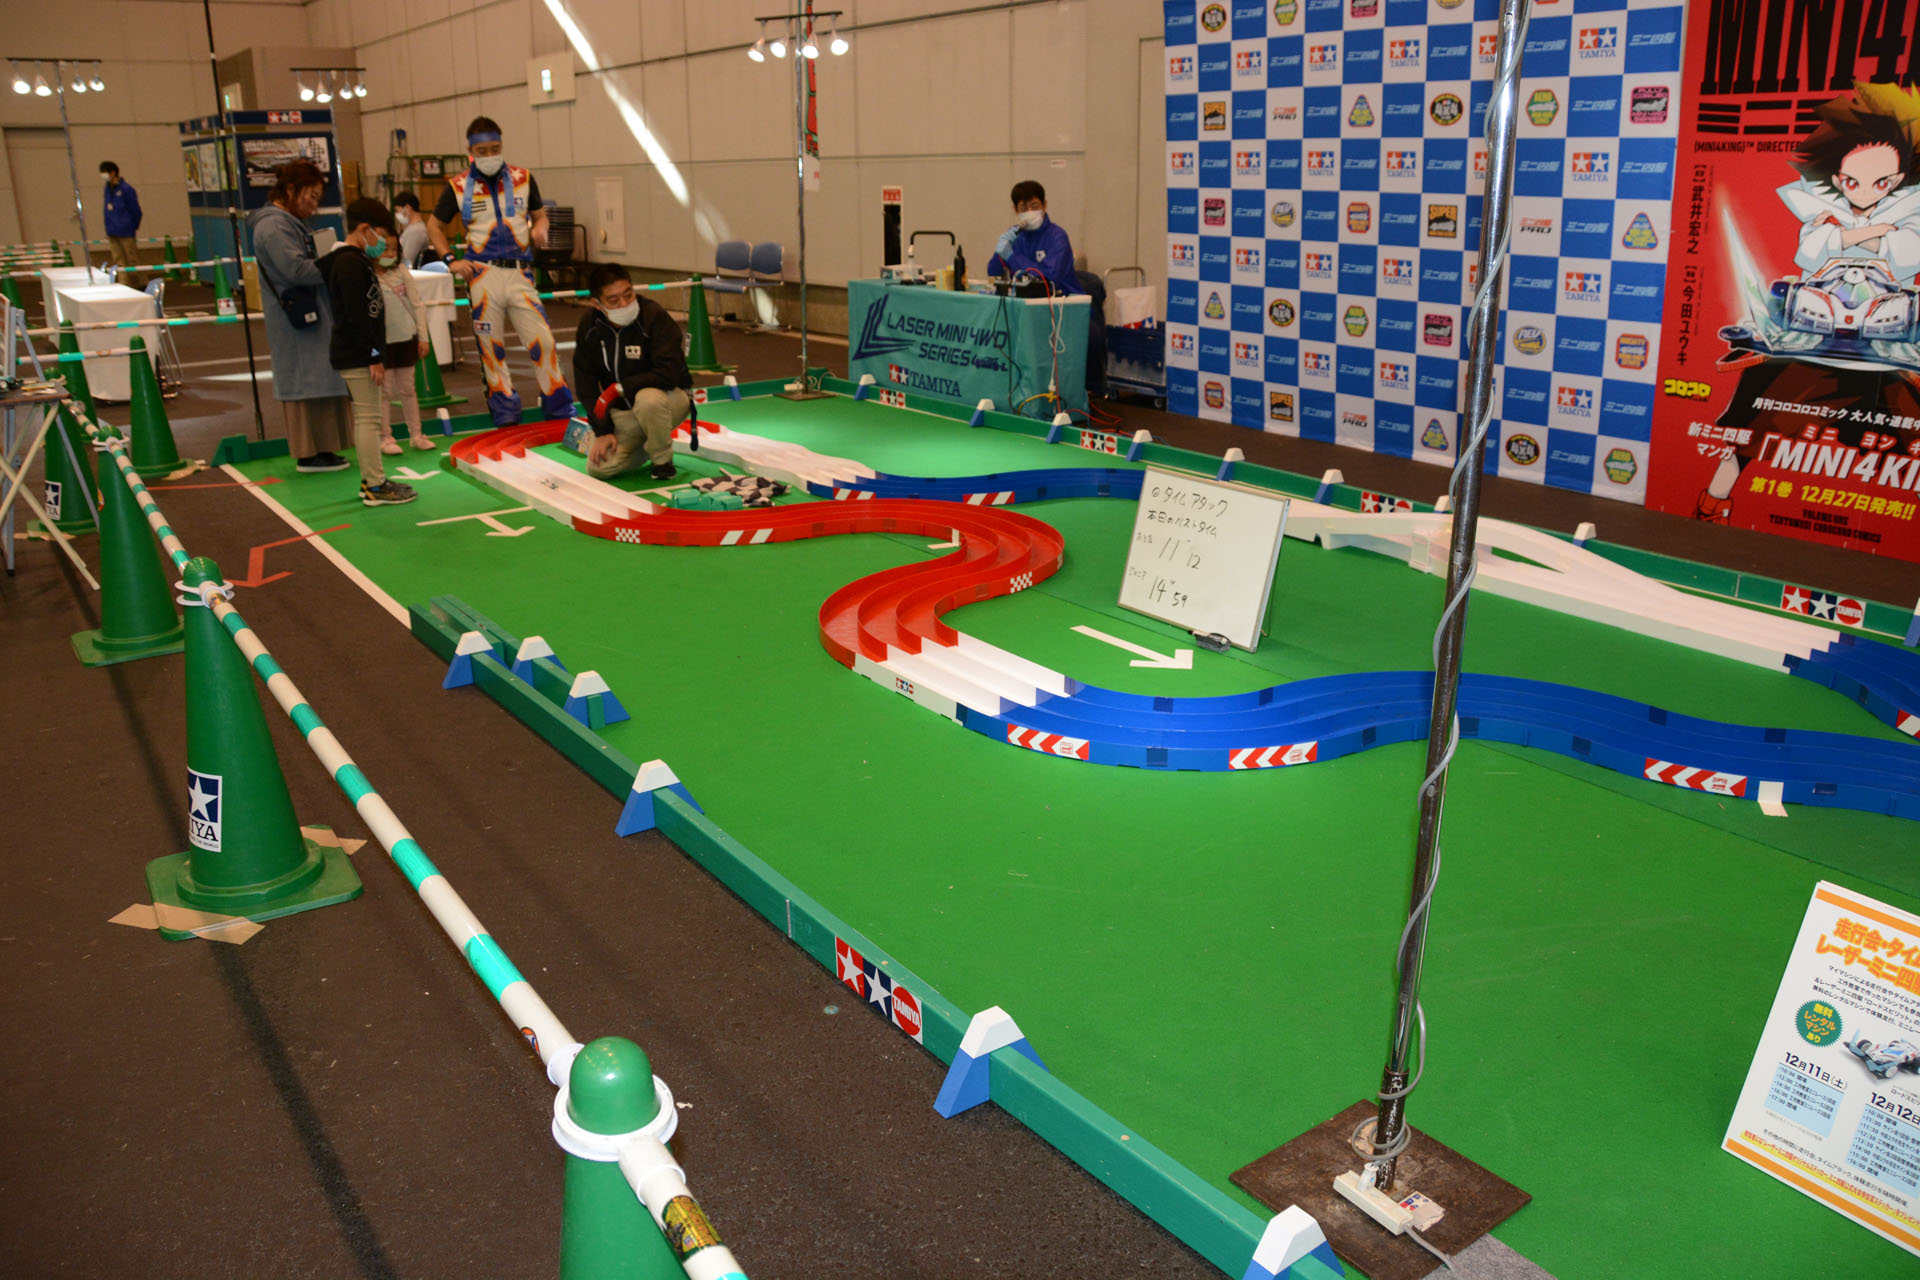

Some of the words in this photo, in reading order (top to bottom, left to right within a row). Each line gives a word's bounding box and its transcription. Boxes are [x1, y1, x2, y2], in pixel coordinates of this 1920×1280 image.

[1580, 49, 1616, 59] TAMIYA
[1310, 63, 1337, 72] TAMIYA
[1390, 58, 1420, 68] TAMIYA
[1308, 168, 1335, 176] TAMIYA
[1387, 169, 1416, 178] TAMIYA
[1572, 172, 1608, 182] TAMIYA
[1687, 186, 1703, 254] 武井宏之
[1306, 270, 1332, 280] TAMIYA
[1383, 277, 1412, 287] TAMIYA
[1564, 292, 1600, 303] TAMIYA
[887, 312, 933, 338] LASER
[935, 324, 969, 344] MINI
[970, 328, 1009, 349] 4WD
[1677, 286, 1695, 366] 今田ユウキ
[918, 343, 971, 367] SERIES
[1304, 368, 1330, 378] TAMIYA
[909, 371, 962, 397] TAMIYA
[1381, 380, 1409, 390] TAMIYA
[1664, 378, 1711, 400] コロコロ
[1557, 405, 1592, 418] TAMIYA
[1752, 397, 1848, 420] 月刊コロコロコミック
[1687, 421, 1752, 445] 新ミニ四駆
[1861, 433, 1895, 449] ヨン
[1696, 442, 1737, 461] マンガ
[1750, 476, 1793, 498] 第1巻
[1801, 485, 1917, 520] 12月27日発売!!
[1837, 605, 1863, 619] TAMIYA
[191, 818, 219, 841] IYA
[893, 997, 921, 1028] TAMIYA
[1813, 1003, 1834, 1019] 無料
[1804, 1010, 1836, 1031] レンタル
[1805, 1021, 1830, 1036] マシン
[1806, 1032, 1821, 1043] あり
